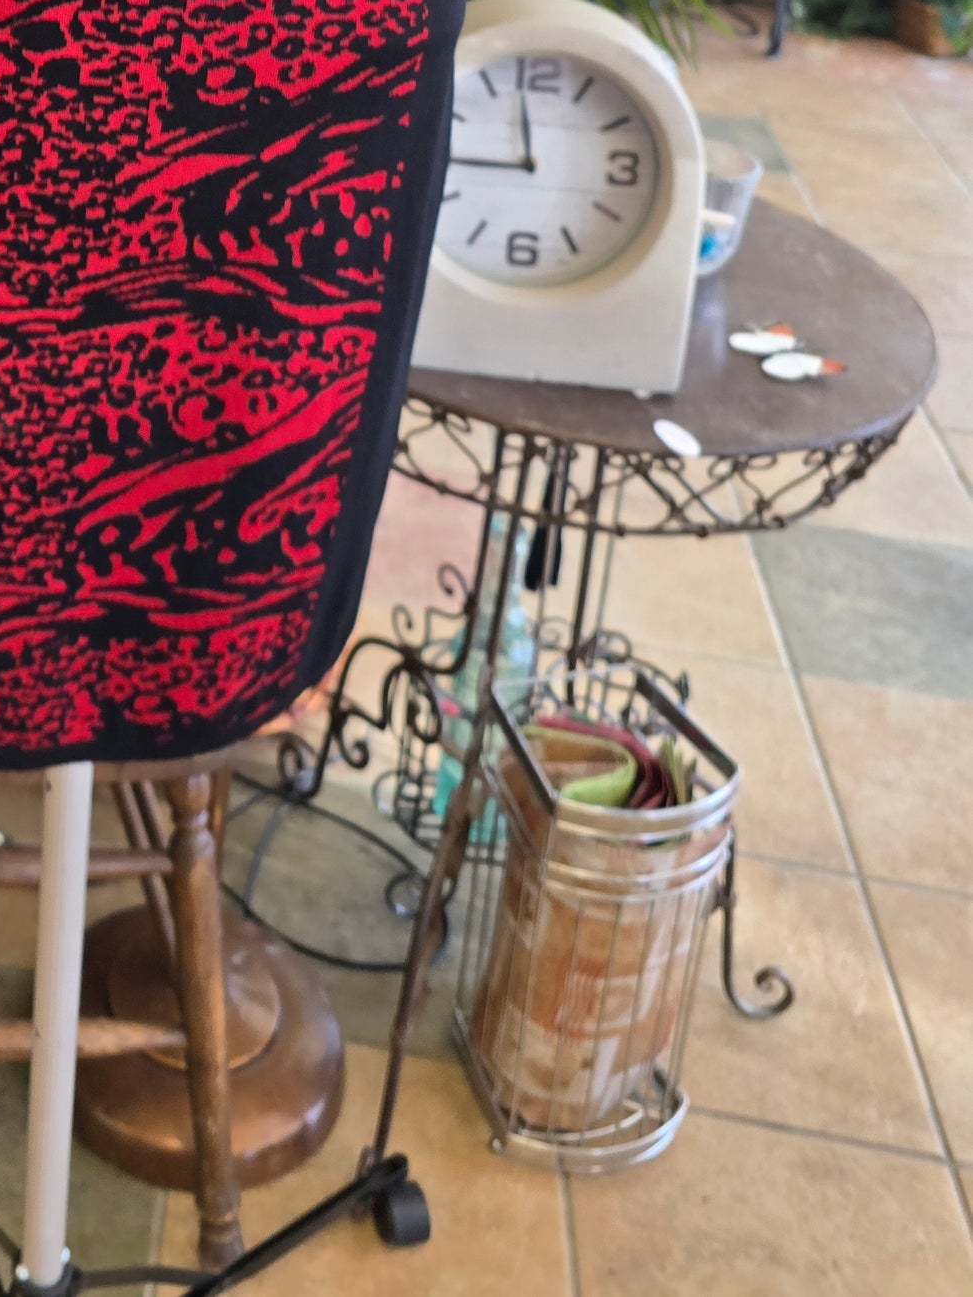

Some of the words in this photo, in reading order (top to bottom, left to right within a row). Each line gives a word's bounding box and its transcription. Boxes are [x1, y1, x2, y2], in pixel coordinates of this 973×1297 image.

[515, 56, 562, 93] 12
[607, 151, 640, 187] 3
[505, 232, 539, 268] 6
